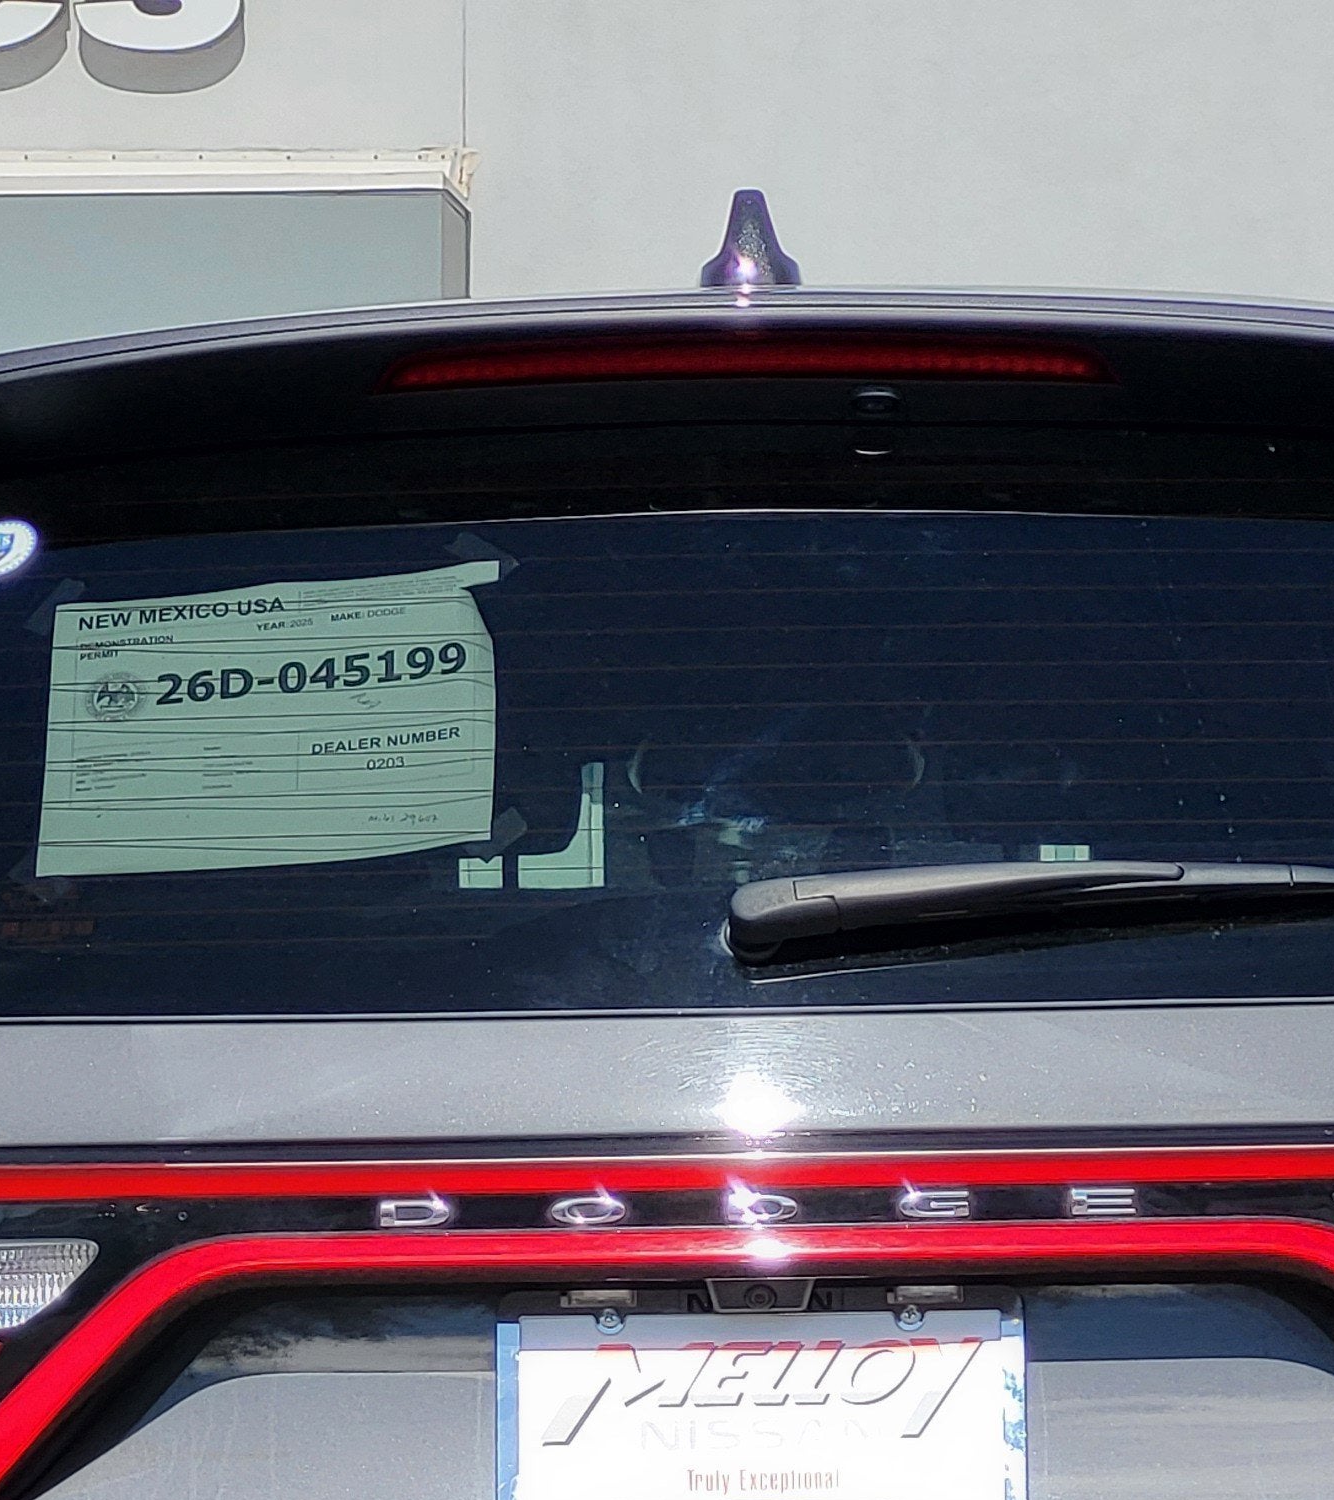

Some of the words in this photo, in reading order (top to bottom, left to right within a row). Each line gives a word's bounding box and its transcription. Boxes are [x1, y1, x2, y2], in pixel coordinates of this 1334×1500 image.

[79, 612, 133, 631] NEW
[139, 602, 229, 625] MEXICO
[237, 597, 285, 615] USA
[366, 606, 406, 618] DODGE
[80, 649, 119, 661] PERMIT
[156, 642, 467, 705] 26D-045199
[312, 737, 381, 755] DEALER
[387, 727, 460, 747] NUMBER
[366, 756, 405, 771] 0203
[378, 1186, 1137, 1228] DODGE
[542, 1337, 983, 1447] MELLOY
[687, 1469, 730, 1495] Truly
[739, 1468, 839, 1494] Exceptional
